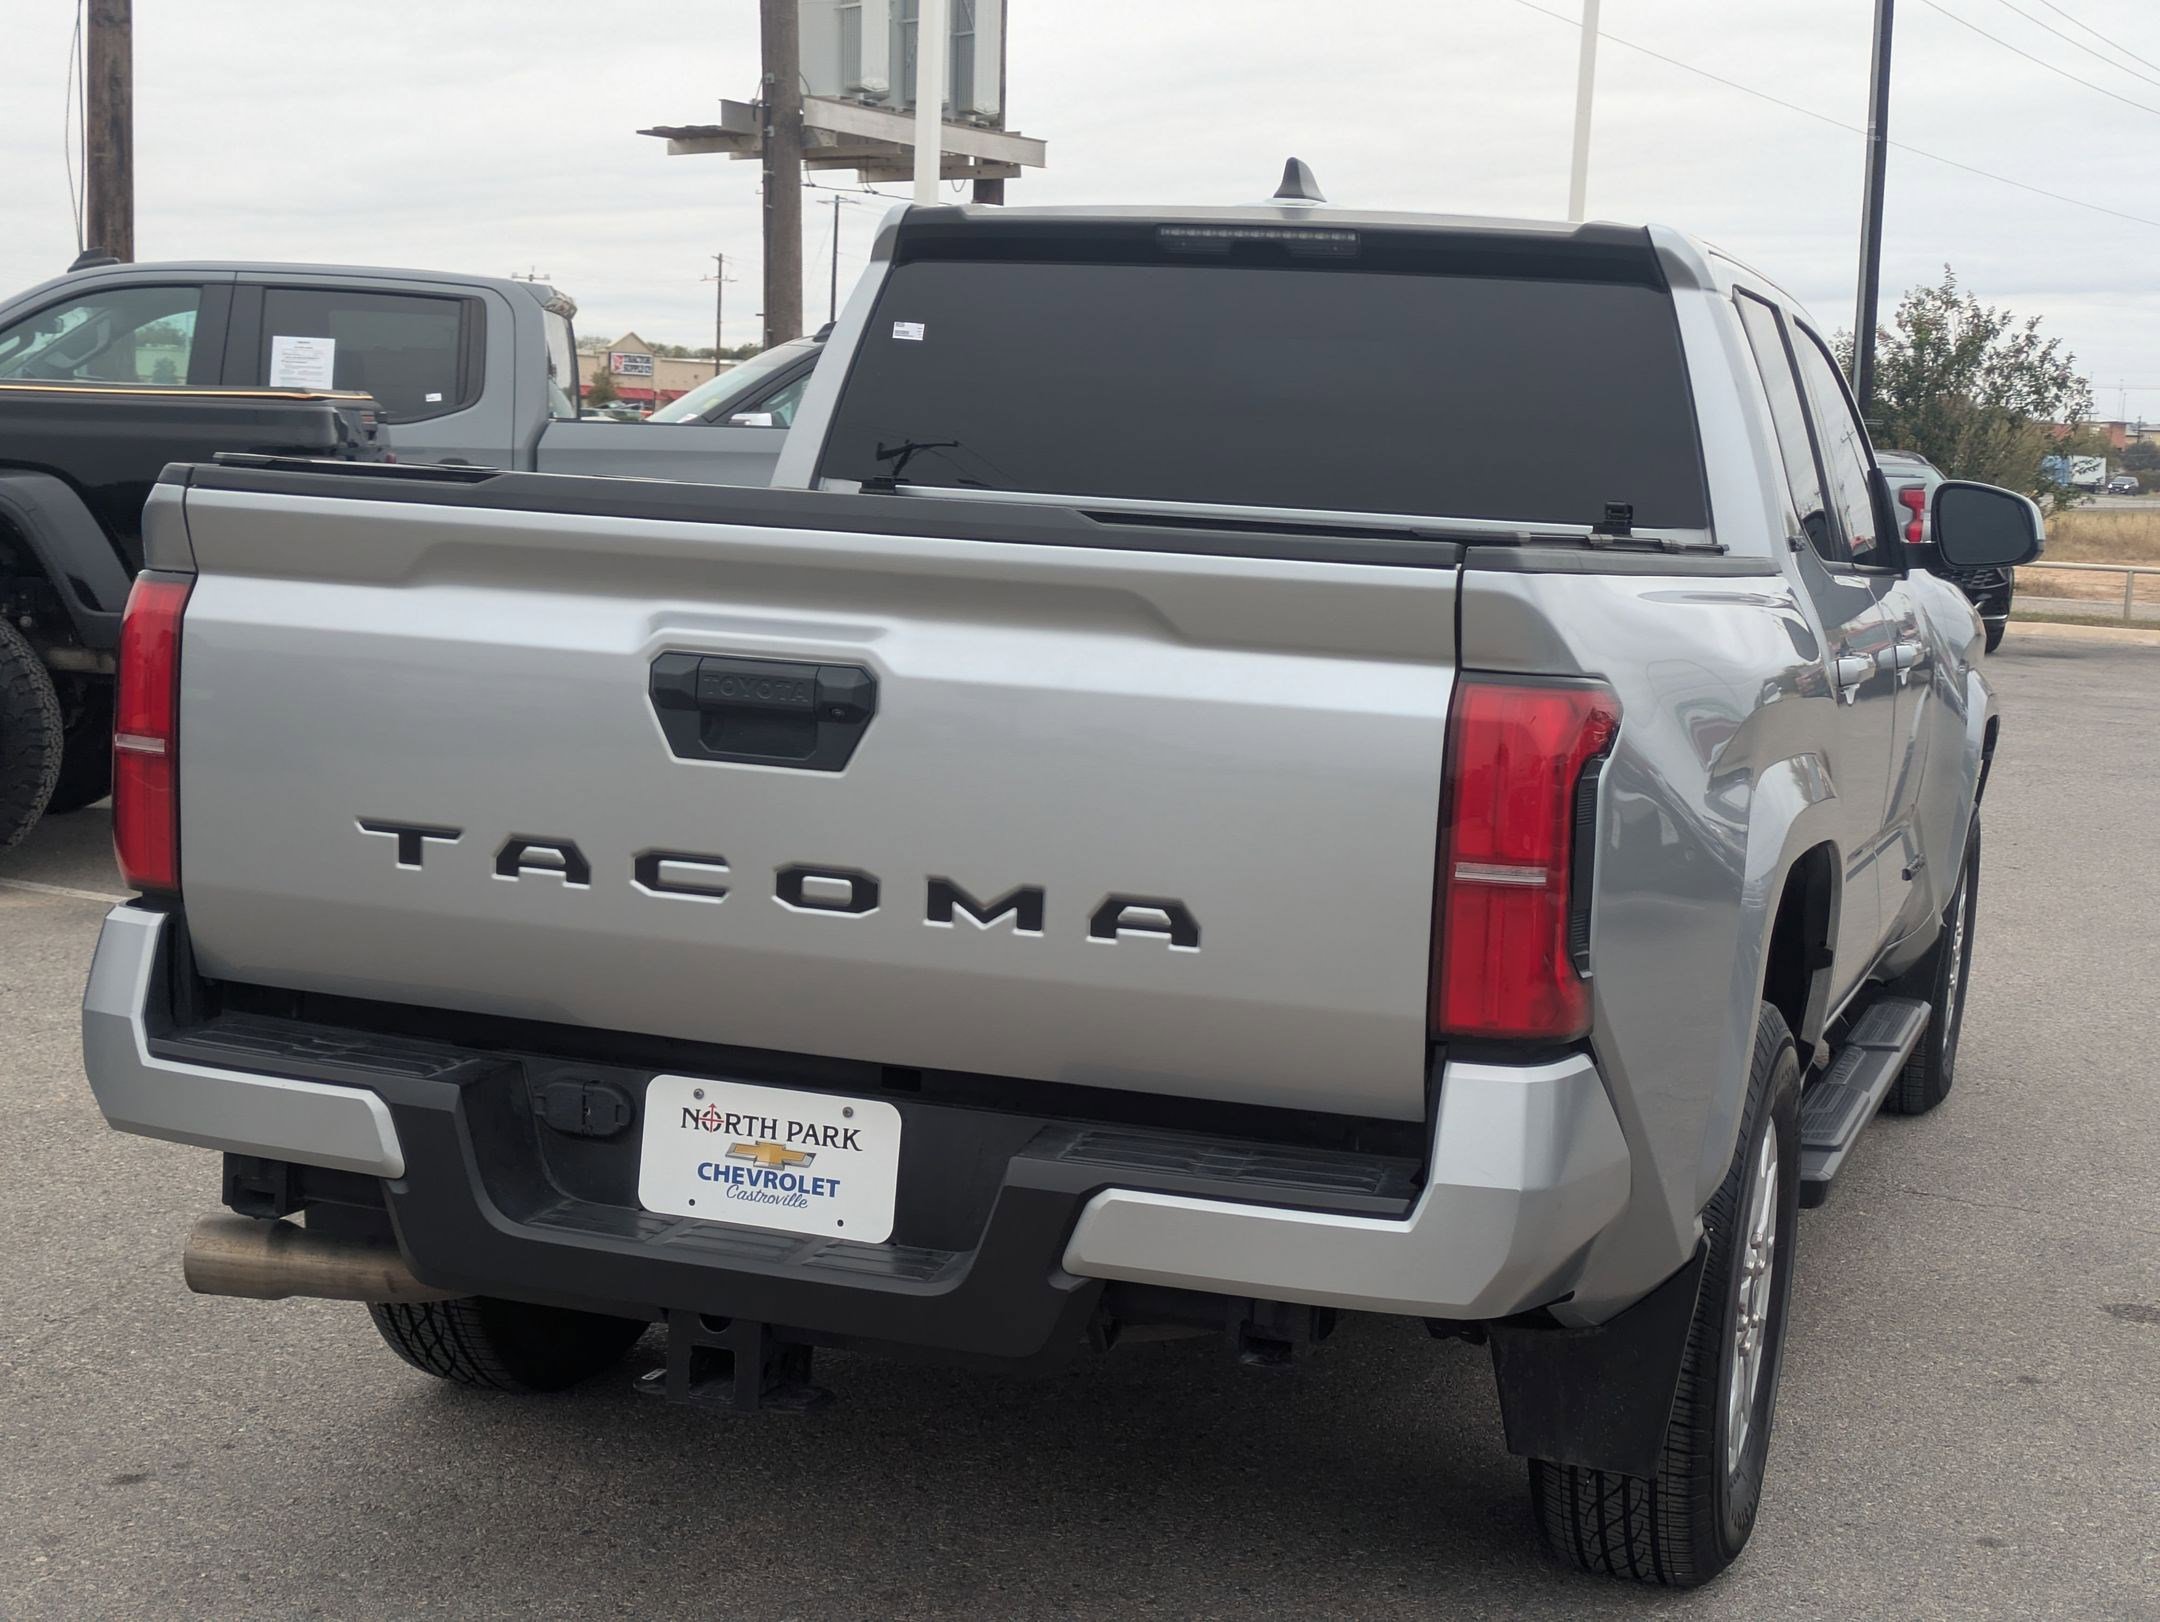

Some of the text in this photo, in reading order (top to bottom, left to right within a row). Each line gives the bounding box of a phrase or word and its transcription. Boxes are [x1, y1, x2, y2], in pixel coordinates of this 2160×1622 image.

[702, 673, 808, 702] TOYOTA
[356, 816, 1201, 953] TACOMA
[680, 1105, 863, 1151] NORTH PARK
[697, 1162, 841, 1198] CHEVROLET
[726, 1184, 808, 1209] Castroville
